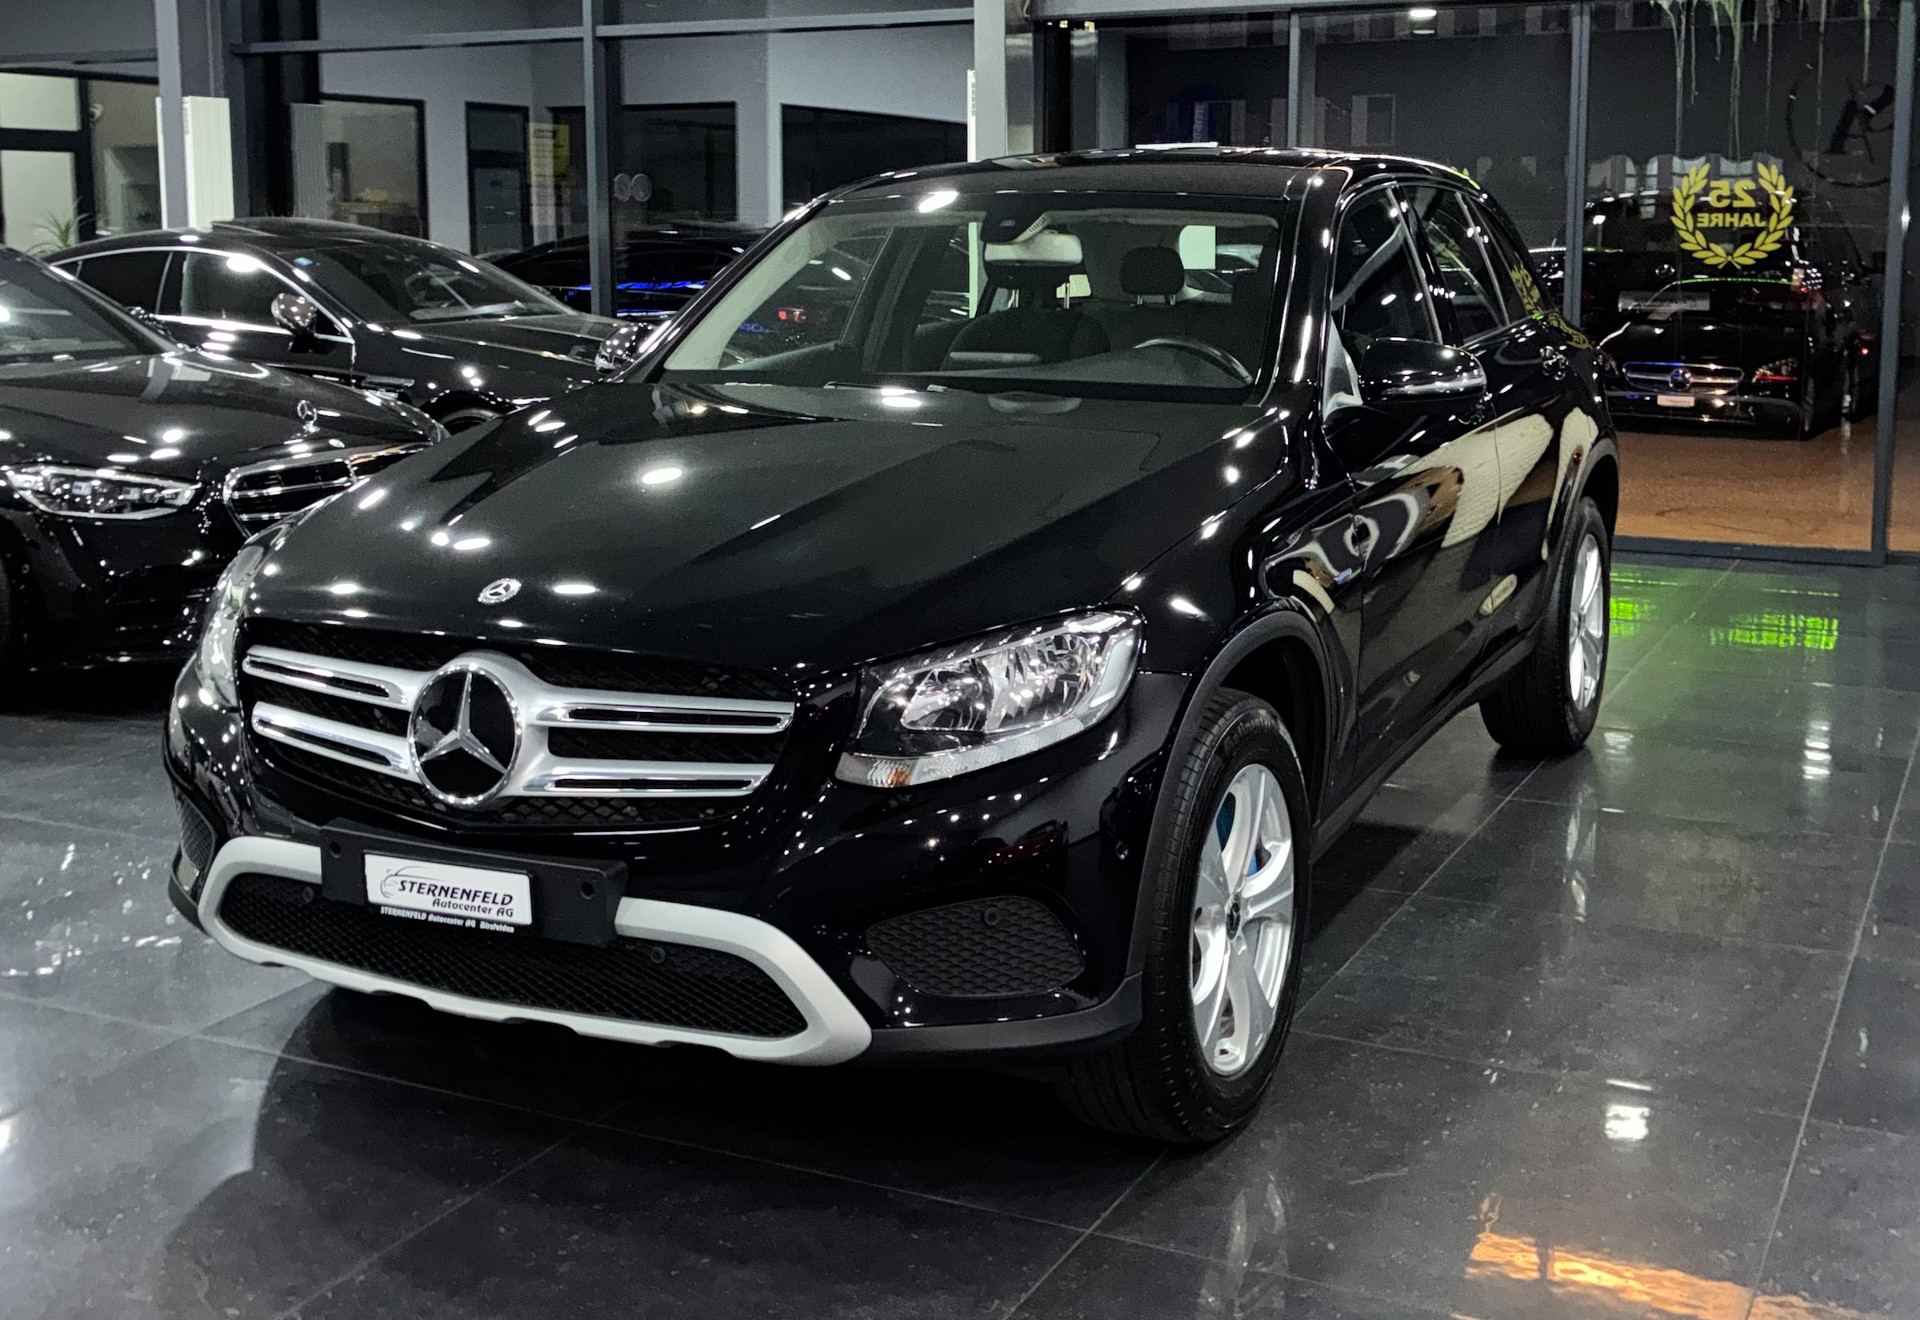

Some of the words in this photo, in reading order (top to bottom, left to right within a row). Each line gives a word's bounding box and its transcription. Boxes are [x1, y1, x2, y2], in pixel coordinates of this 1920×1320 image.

[398, 879, 514, 906] STERNENFELD
[380, 906, 427, 921] STERNENFELD
[428, 913, 464, 927] Autocenter
[465, 918, 476, 929] AG
[432, 898, 493, 915] Autocenter
[496, 907, 514, 918] AG
